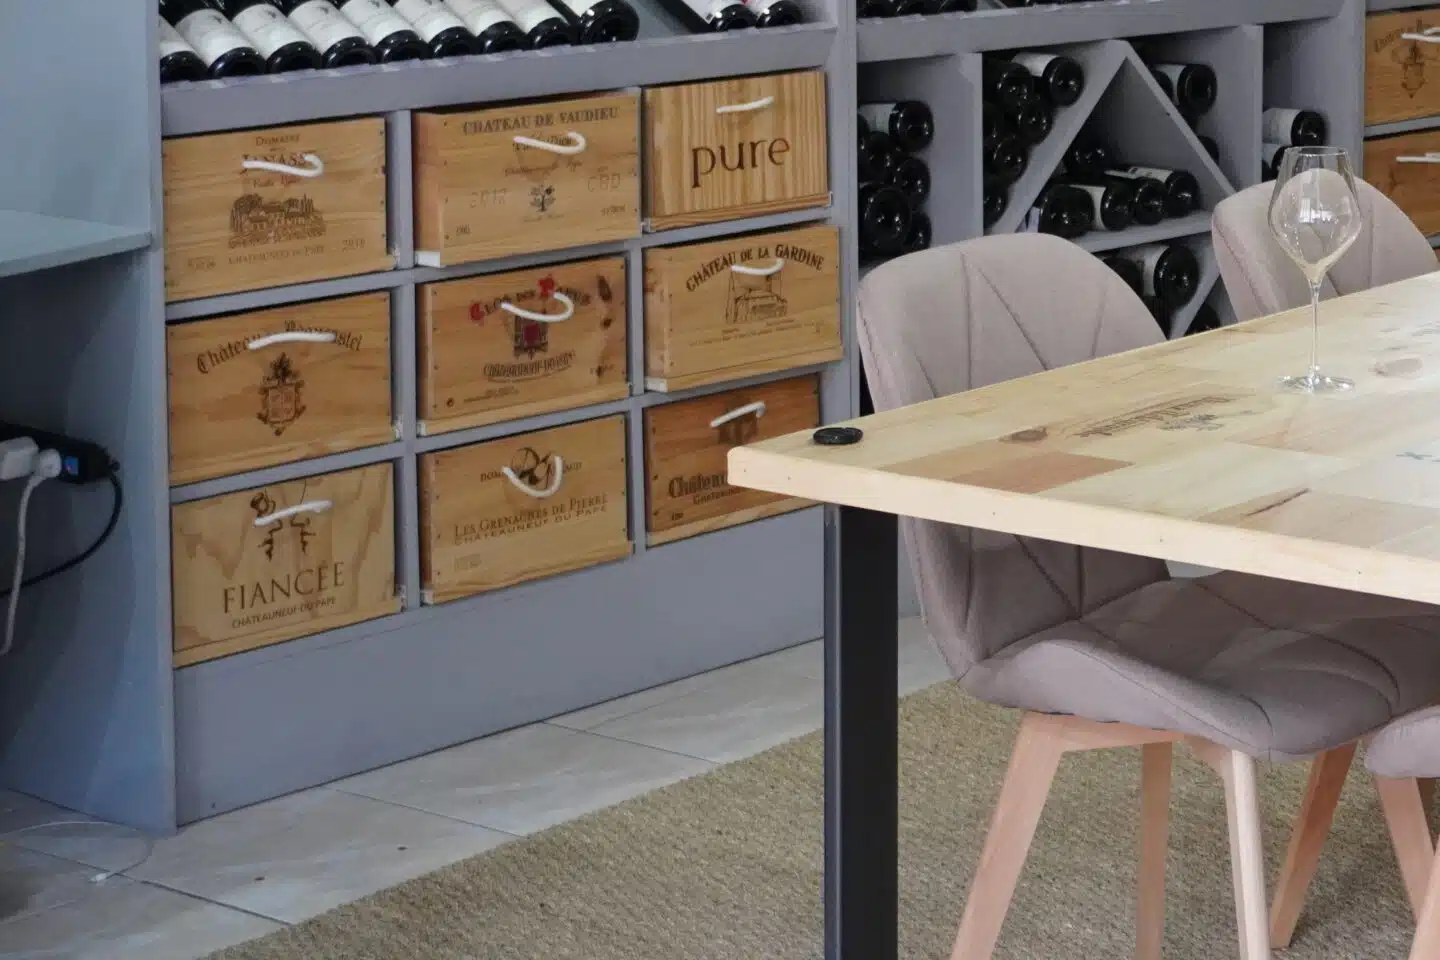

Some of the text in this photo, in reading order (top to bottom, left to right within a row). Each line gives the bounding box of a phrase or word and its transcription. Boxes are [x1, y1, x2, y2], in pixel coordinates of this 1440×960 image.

[535, 112, 554, 128] DE
[560, 106, 620, 123] VAUDIEU
[691, 137, 791, 189] pure
[740, 249, 753, 262] DE
[758, 247, 770, 259] LA
[775, 243, 825, 271] GARDINE
[455, 492, 609, 538] LES GRENACHES DE PIERRE
[222, 559, 345, 614] FIANCÉE
